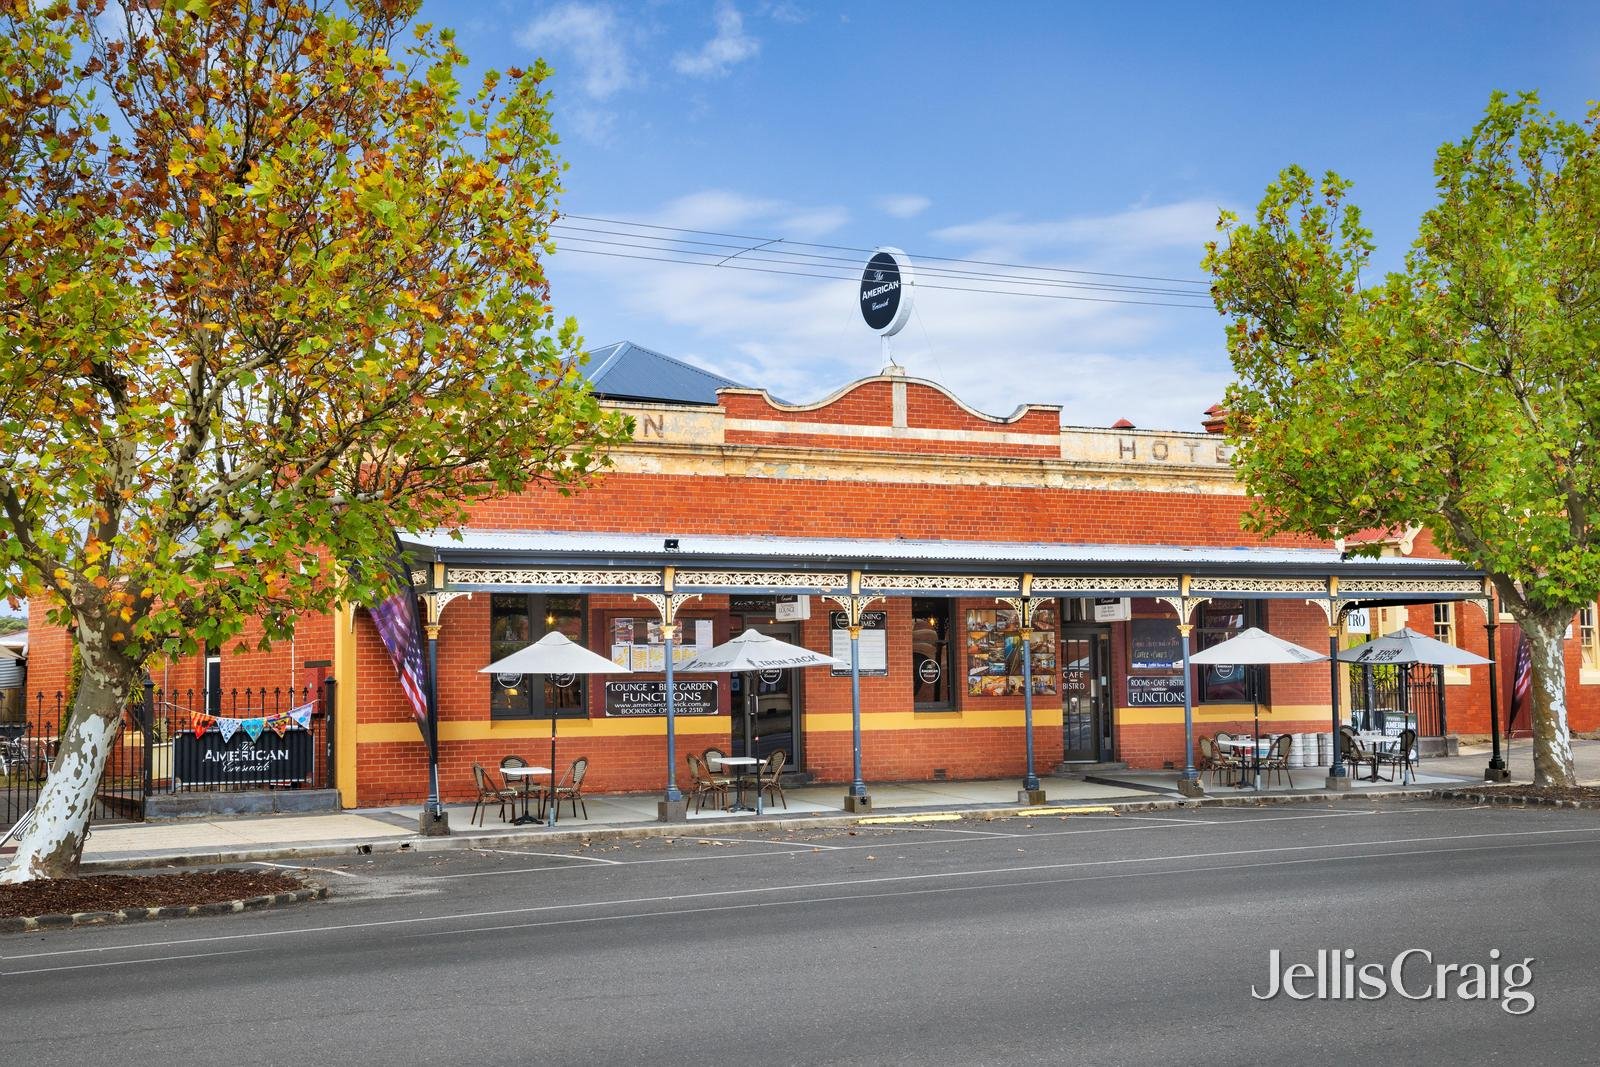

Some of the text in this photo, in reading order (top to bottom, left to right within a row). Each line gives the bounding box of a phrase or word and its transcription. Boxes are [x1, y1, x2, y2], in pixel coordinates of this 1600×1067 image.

[862, 280, 899, 300] AMERICAN
[1118, 438, 1231, 464] HOTE
[1348, 613, 1366, 627] TRO
[760, 655, 819, 668] IRON JACK
[1062, 671, 1084, 679] CAFE
[611, 682, 713, 691] LOUNGE BER GARDEN
[1062, 682, 1086, 690] BISTRO
[623, 691, 701, 702] FUNCTONS
[1385, 721, 1416, 729] AMERIAN
[203, 748, 289, 762] AMERICAN
